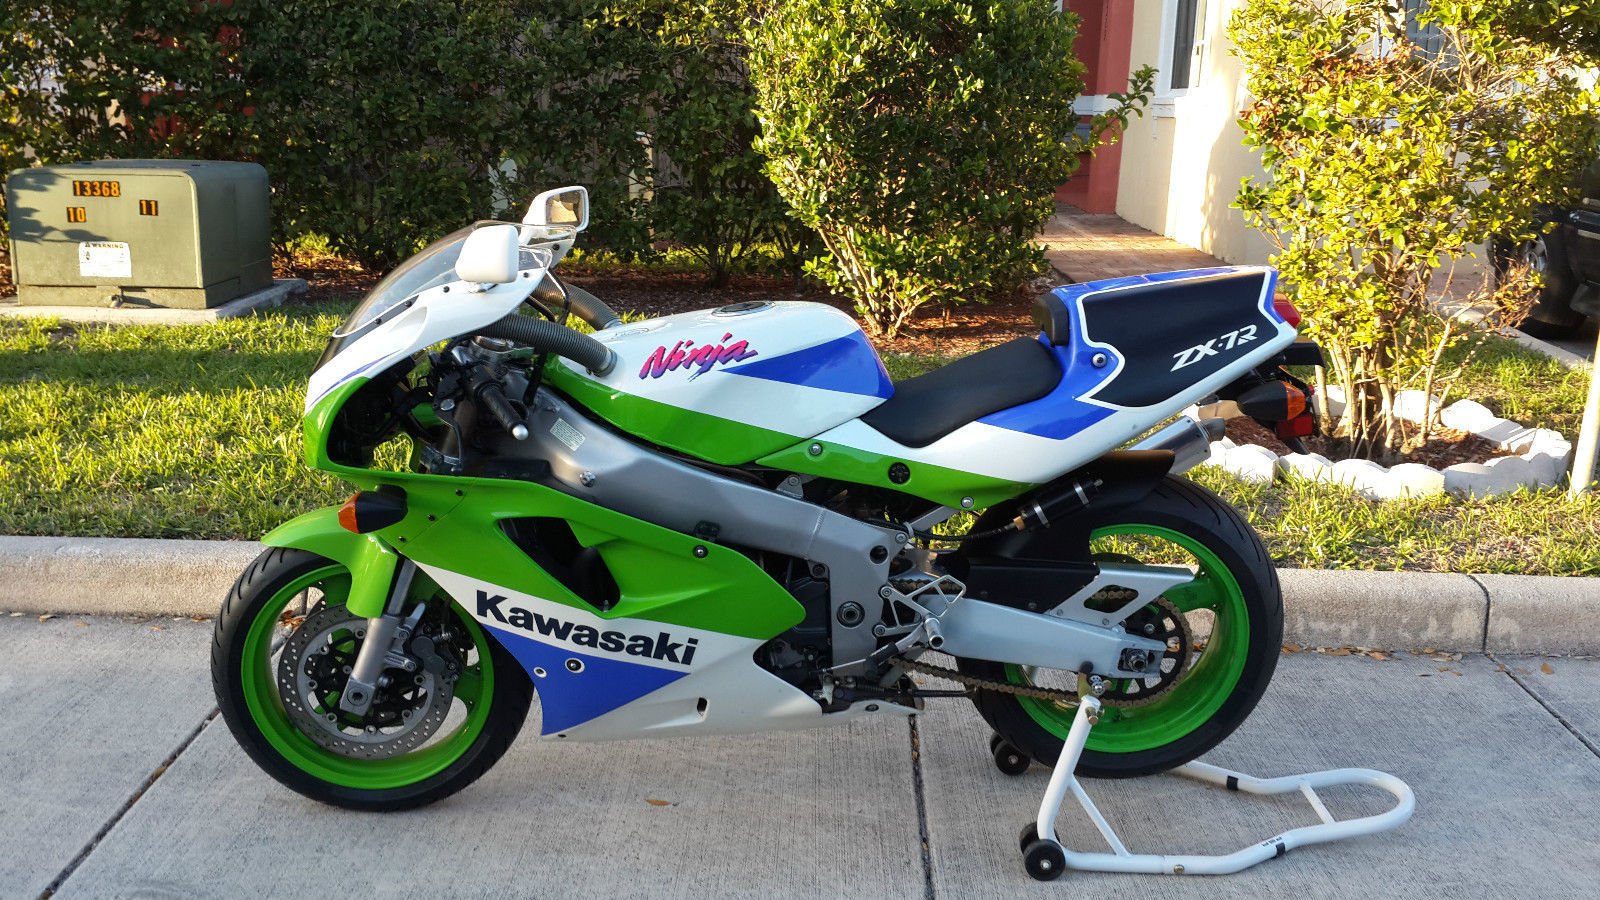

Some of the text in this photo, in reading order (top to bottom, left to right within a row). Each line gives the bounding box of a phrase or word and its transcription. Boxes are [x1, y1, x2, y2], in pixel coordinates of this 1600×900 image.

[74, 181, 120, 196] 13368
[67, 207, 85, 222] 10
[140, 200, 157, 215] 11
[638, 332, 758, 382] Ninja
[476, 589, 699, 665] Kawasaki
